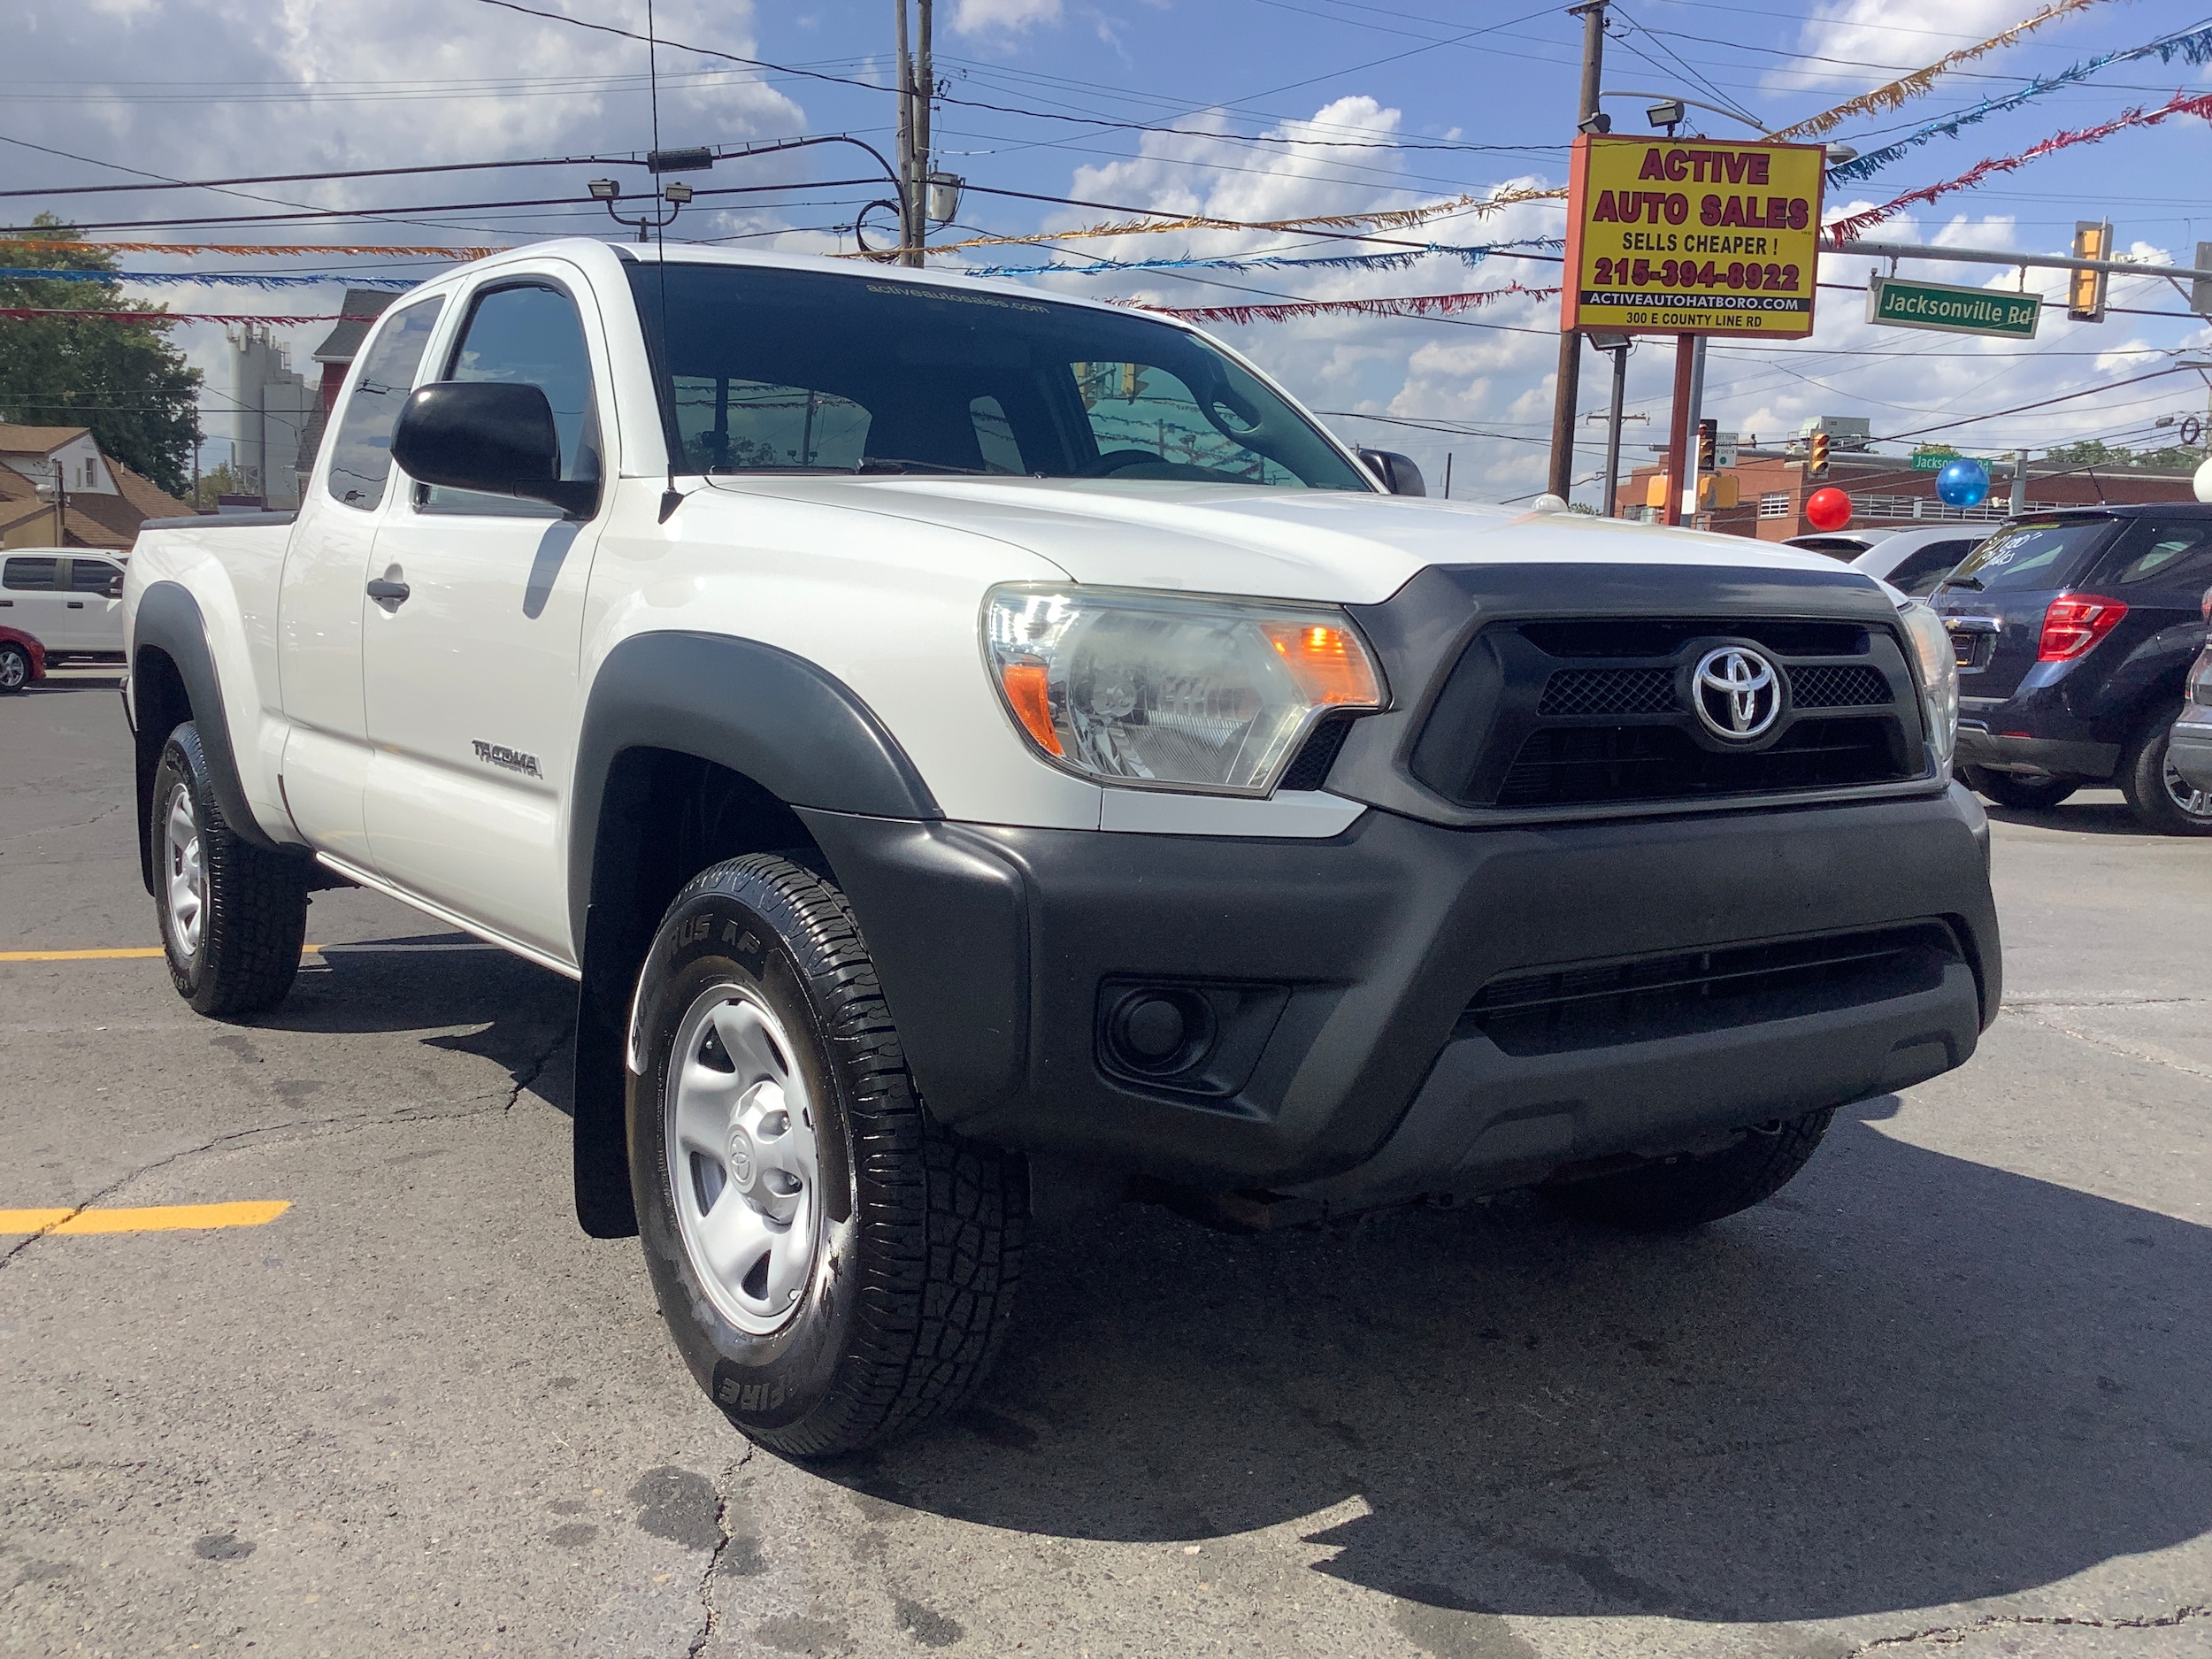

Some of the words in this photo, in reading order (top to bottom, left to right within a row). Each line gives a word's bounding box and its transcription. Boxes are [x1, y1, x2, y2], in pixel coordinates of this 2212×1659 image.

[1639, 148, 1770, 185] ACTIVE
[1593, 190, 1688, 225] AUTO
[1699, 194, 1809, 230] SALES
[1622, 232, 1678, 252] SELLS
[1684, 234, 1767, 255] CHEAPER
[1593, 257, 1800, 292] 215-394-8922
[865, 282, 1051, 314] activeautosales.com
[1589, 292, 1799, 311] ACTIVEAUTOHATBORO.COM
[1885, 293, 2002, 322] Jacksonville
[2008, 305, 2032, 325] Rd
[1626, 312, 1647, 324] 300
[1651, 313, 1658, 324] E
[1662, 313, 1712, 326] COUNTY
[1716, 315, 1744, 326] LINE
[1746, 316, 1762, 327] RD
[472, 739, 543, 780] TACOMA
